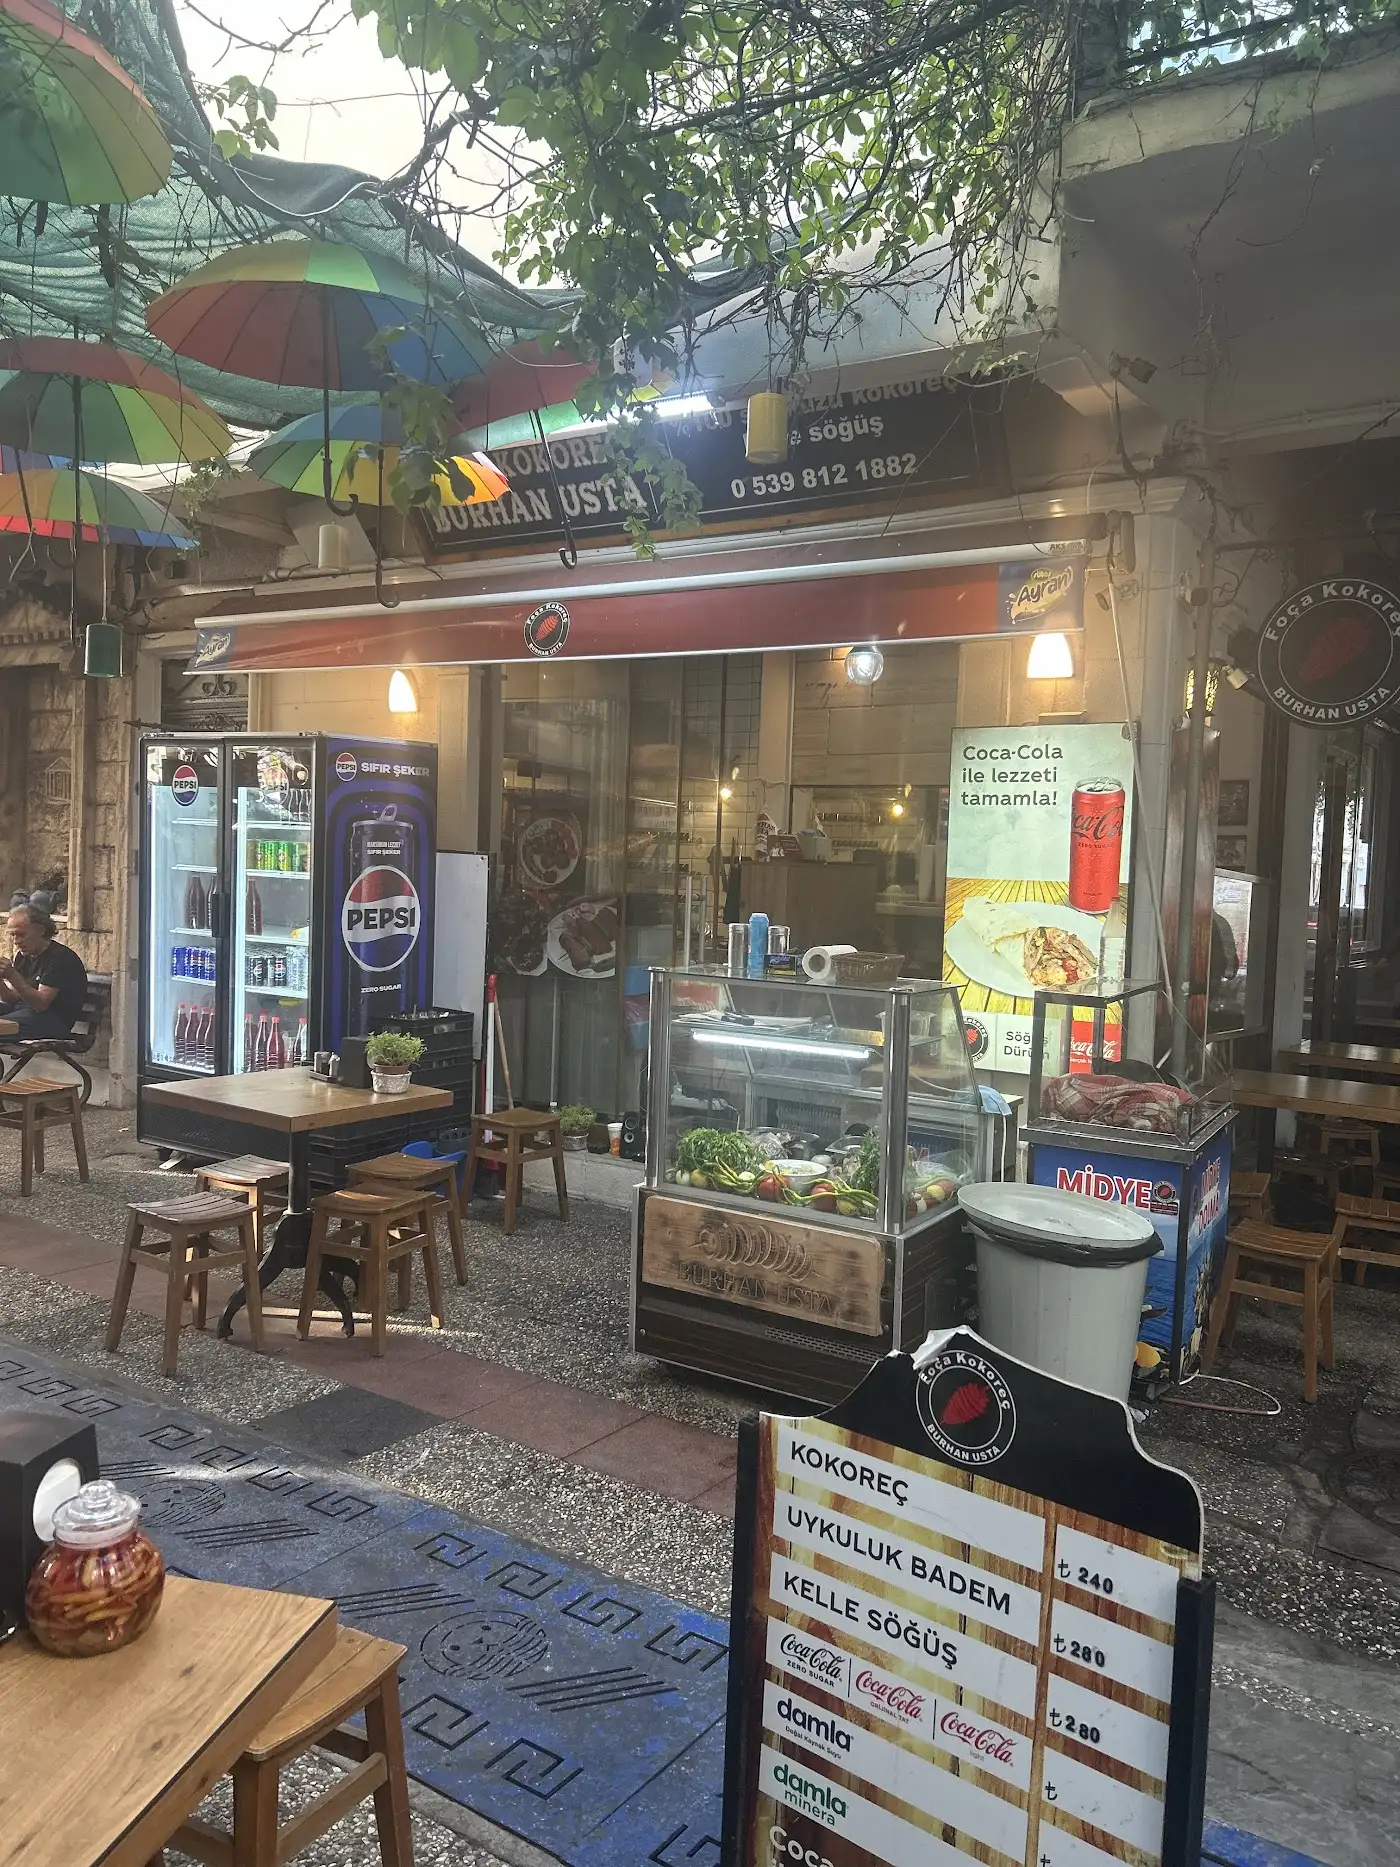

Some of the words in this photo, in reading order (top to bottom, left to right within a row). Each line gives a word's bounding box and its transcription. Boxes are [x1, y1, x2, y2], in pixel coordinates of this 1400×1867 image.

[808, 414, 884, 442] söğüş
[730, 478, 746, 499] 0
[752, 471, 795, 496] 539
[802, 463, 848, 489] 812
[855, 453, 918, 481] 1882
[560, 474, 648, 518] USTA
[1018, 571, 1069, 606] Ayran
[1265, 594, 1314, 641] Foça
[1273, 687, 1340, 719] BURHAN
[1345, 687, 1391, 716] USTA
[337, 762, 356, 771] PEPSI
[361, 762, 391, 774] SIFIR
[392, 765, 430, 777] ŞEKER
[963, 743, 1064, 761] Coca-Cola
[174, 780, 197, 790] PEPSI
[962, 767, 985, 783] ile
[992, 766, 1057, 783] lezzeti
[961, 790, 1057, 806] tamamla!
[347, 906, 416, 931] PEPSI
[361, 986, 378, 994] ZERO
[379, 983, 402, 992] SUGAR
[1058, 1166, 1152, 1209] MİDYE
[677, 1262, 768, 1301] BURHAN
[776, 1280, 836, 1316] USTA
[956, 1352, 1011, 1411] Kokoreç
[926, 1423, 970, 1461] BURHAN
[972, 1445, 1001, 1462] USTA
[791, 1441, 909, 1507] KOKOREÇ
[787, 1505, 903, 1571] UYKULUK
[911, 1555, 1011, 1615] BADEM
[1078, 1567, 1115, 1596] 240
[784, 1571, 860, 1623] KELLE
[867, 1608, 958, 1670] SÖĞÜŞ
[780, 1633, 847, 1681] Coca-Cola
[787, 1659, 807, 1674] ZERO
[808, 1669, 835, 1688] SUGAR
[855, 1670, 926, 1720] Coca-Cola
[777, 1698, 851, 1753] damla
[785, 1725, 803, 1740] Doğal
[804, 1735, 826, 1752] Kaynak
[826, 1747, 842, 1760] Suyu
[940, 1711, 1018, 1764] Coca-Cola
[773, 1763, 847, 1818] damla
[784, 1790, 836, 1827] minera
